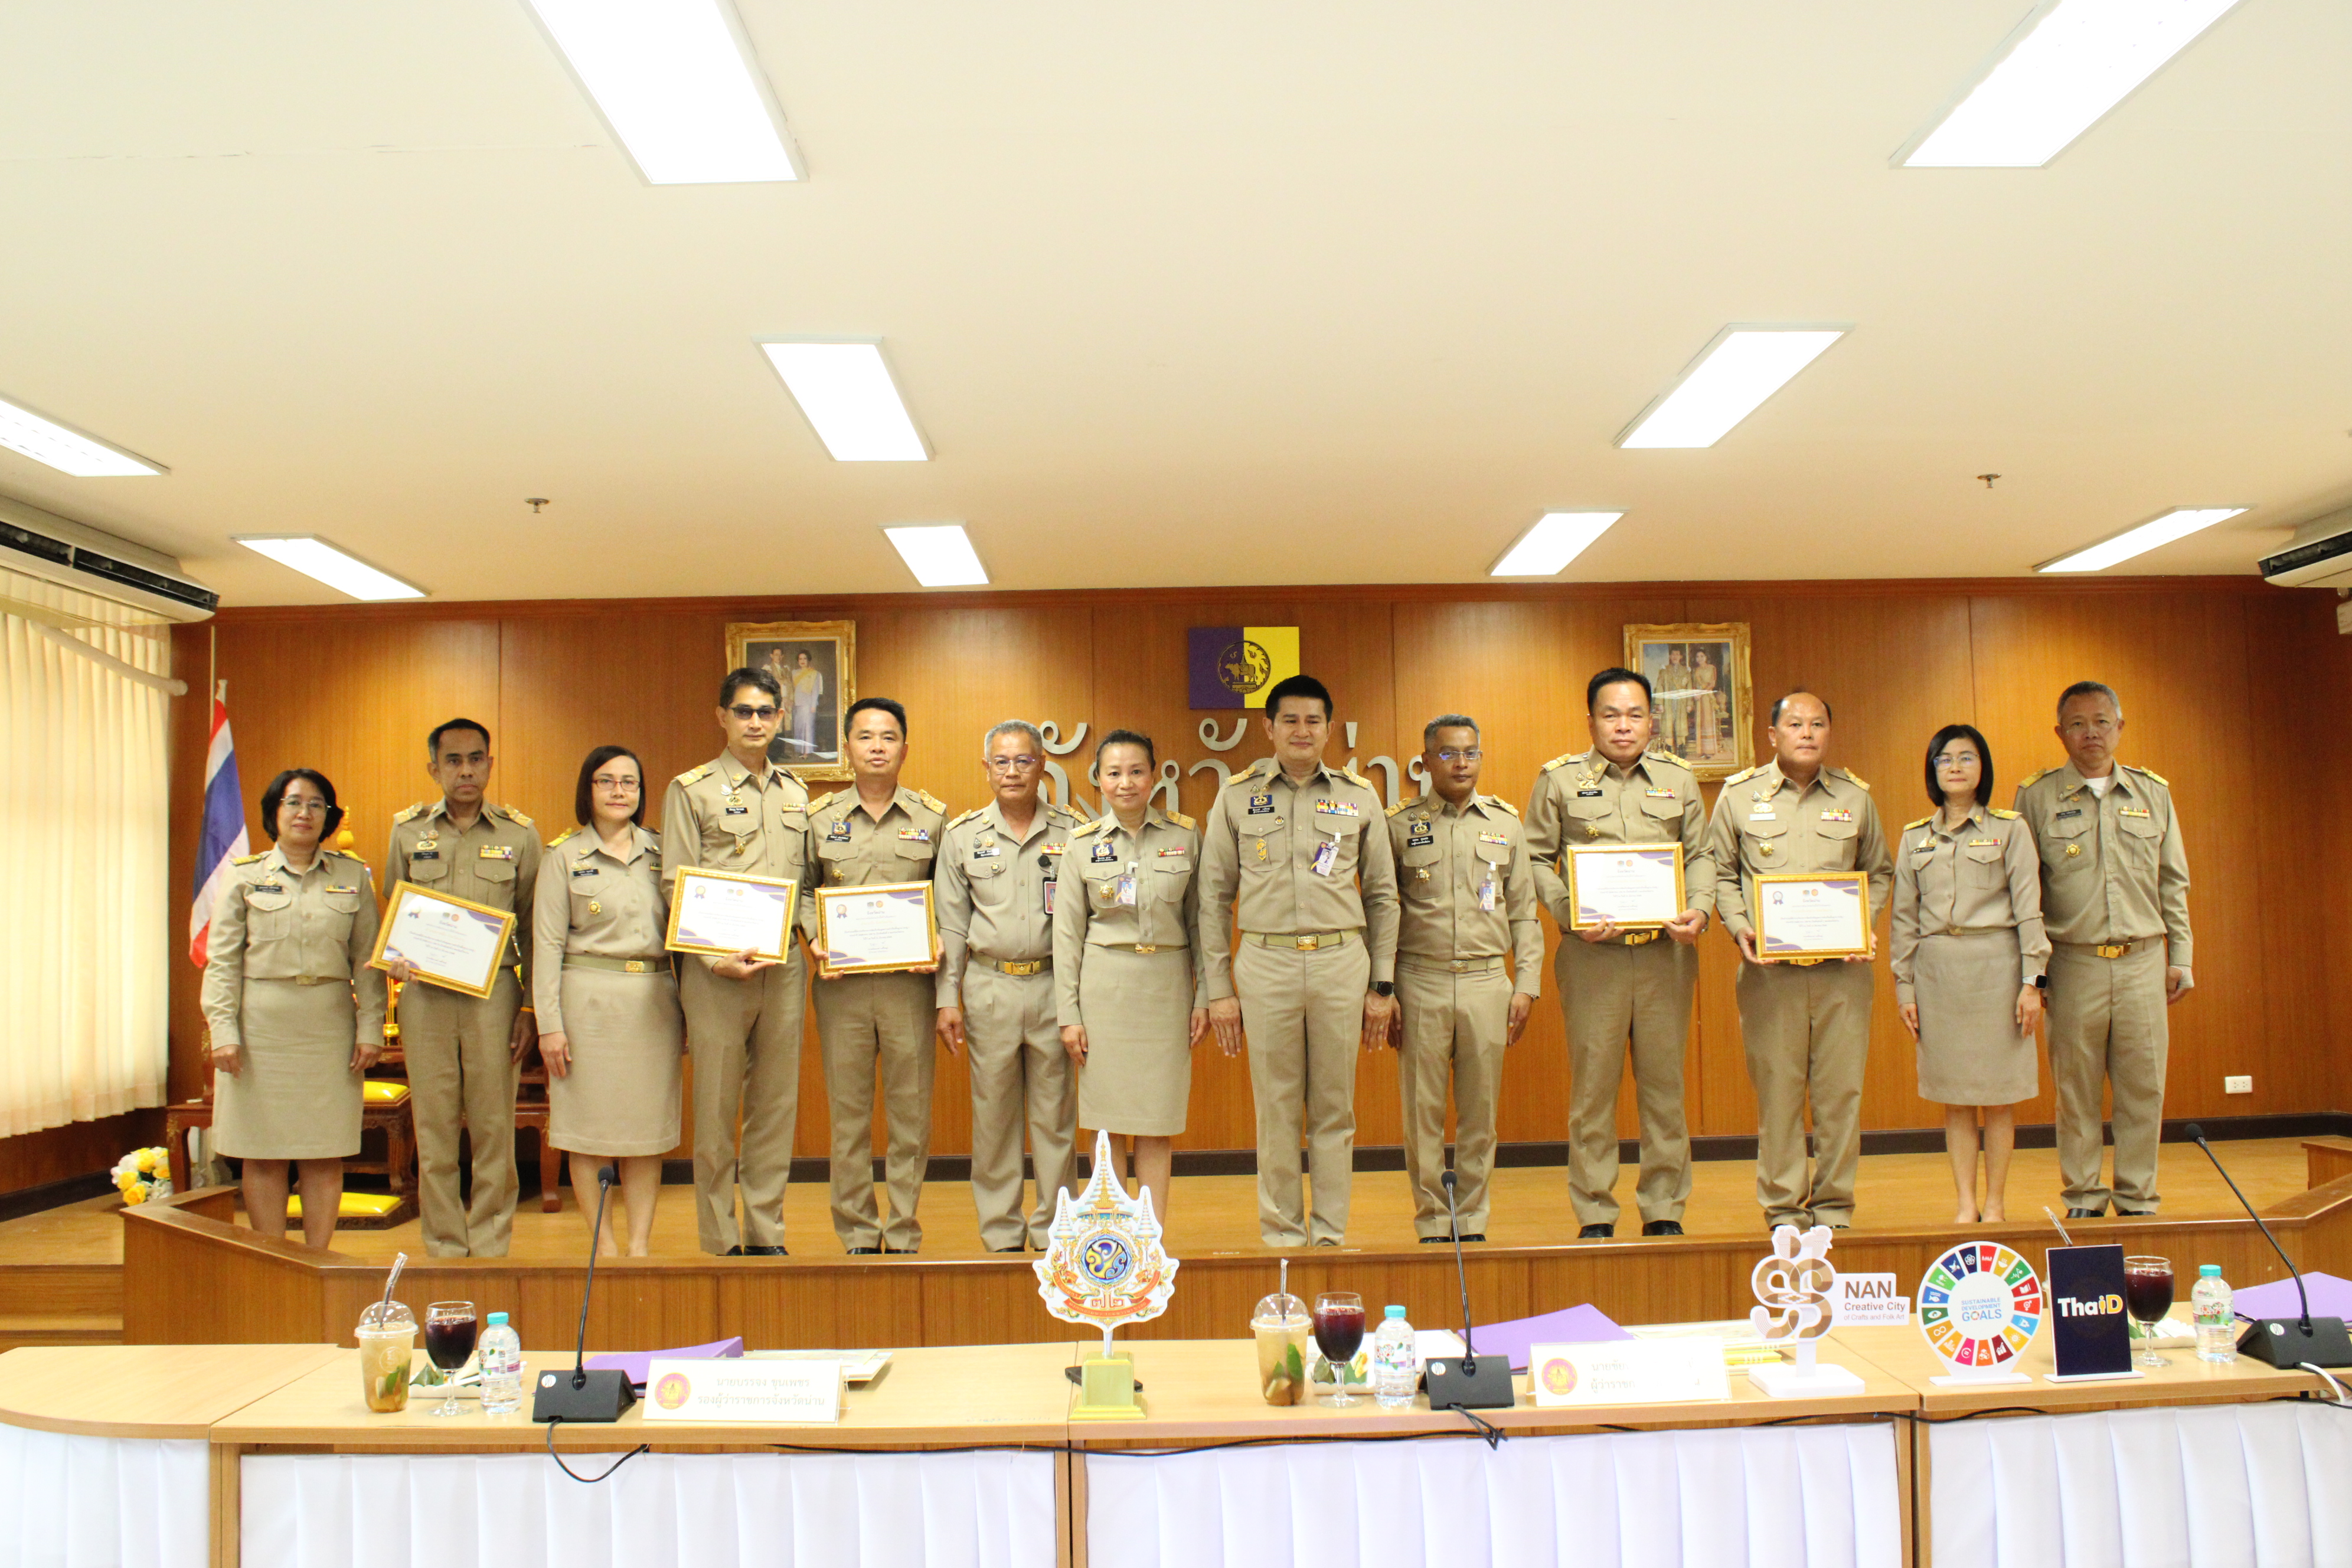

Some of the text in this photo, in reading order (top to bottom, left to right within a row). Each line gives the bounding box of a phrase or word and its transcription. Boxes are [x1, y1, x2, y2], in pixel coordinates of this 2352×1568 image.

[1844, 1280, 1892, 1299] NAN
[1844, 1301, 1906, 1312] Creative City
[1961, 1296, 2001, 1305] SUSTAINABLE
[1961, 1303, 2001, 1311] DEVELOPMENT
[1961, 1308, 2003, 1322] GOALS
[716, 1377, 811, 1391] นายบรรจง ขุนเพชร
[697, 1391, 825, 1409] รองผู้ว่าราชการจังหวัดน่าน
